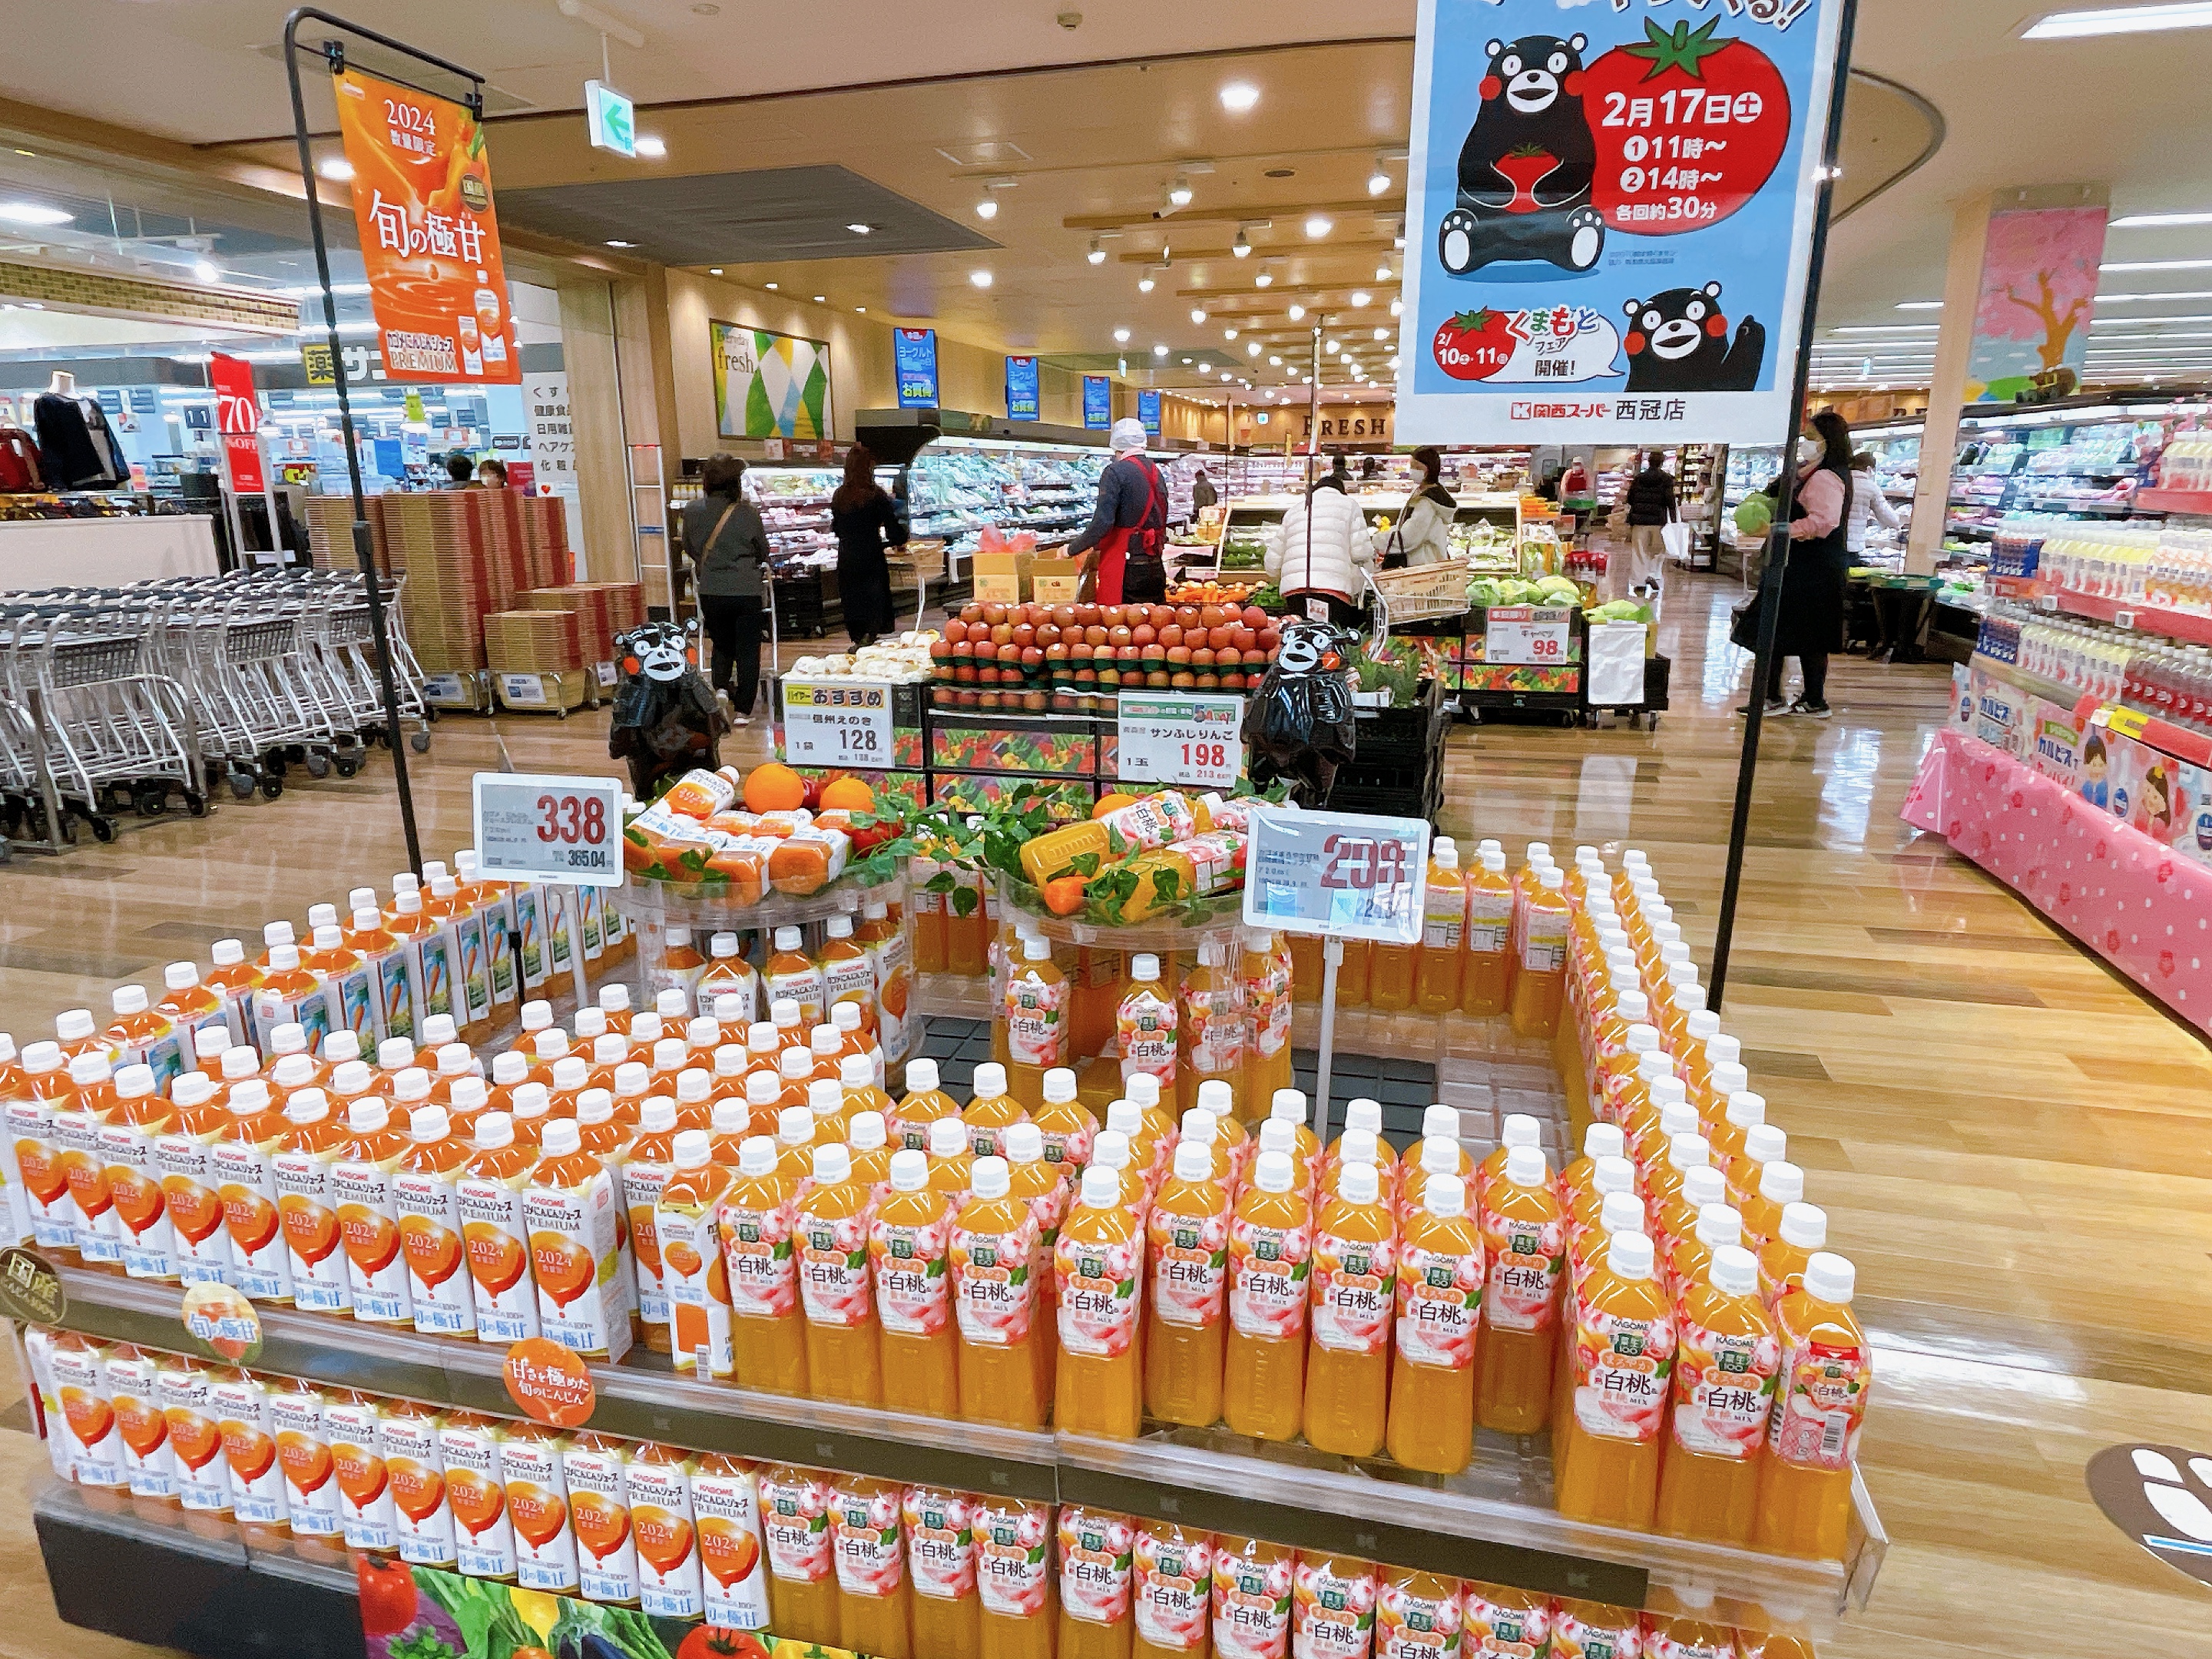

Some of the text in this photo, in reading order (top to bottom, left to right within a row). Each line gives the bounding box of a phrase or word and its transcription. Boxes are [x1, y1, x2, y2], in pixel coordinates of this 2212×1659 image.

[384, 99, 435, 136] 2024
[1615, 195, 1718, 222] 各回約30分
[368, 188, 486, 265] 旬の極甘
[1508, 306, 1598, 343] くまもと
[1535, 337, 1568, 353] フェア
[390, 351, 459, 372] PREMIUM
[717, 346, 754, 374] fresh
[218, 394, 257, 434] 70
[534, 405, 571, 417] 健康食
[1533, 402, 1611, 419] 関西スーパー
[1615, 399, 1686, 422] 西冠店
[537, 423, 573, 435] 日用雑
[1303, 415, 1386, 435] FRESH
[541, 459, 577, 472] 化粧
[1532, 640, 1558, 656] 98
[814, 688, 882, 707] おすすめ
[813, 714, 873, 727] 信州えのき
[839, 728, 877, 751] 128
[1150, 727, 1234, 741] サンふじりんご
[1181, 743, 1225, 767] 198
[536, 794, 607, 845] 338
[1018, 1018, 1044, 1035] 白桃
[1137, 1042, 1167, 1057] 白桃
[226, 1201, 257, 1219] 2024
[286, 1211, 319, 1229] 2024
[345, 1221, 378, 1239] 2024
[1508, 1221, 1542, 1232] KAGOME
[406, 1232, 441, 1251] 2024
[469, 1240, 505, 1258] 2024
[537, 1249, 572, 1267] 2024
[738, 1255, 774, 1276] 白桃
[811, 1263, 848, 1285] 白桃
[889, 1271, 926, 1294] 白桃
[1169, 1261, 1209, 1284] 白桃
[1503, 1267, 1545, 1290] 白桃
[971, 1280, 1011, 1303] 白桃
[1249, 1273, 1290, 1297] 白桃
[1075, 1290, 1114, 1315] 白桃
[1337, 1287, 1377, 1311] 白桃
[1419, 1301, 1462, 1326] 白桃
[190, 1313, 256, 1340] 旬の極甘
[1611, 1319, 1650, 1331] KAGOME
[1715, 1335, 1755, 1348] KAGOME
[1604, 1354, 1651, 1372] まろやか
[1604, 1369, 1651, 1396] 白桃
[1708, 1371, 1757, 1389] まろやか
[518, 1379, 584, 1406] 旬のにんじん
[1708, 1386, 1757, 1412] 白桃
[393, 1473, 424, 1489] 2024
[452, 1484, 484, 1501] 2024
[512, 1496, 546, 1515] 2024
[577, 1507, 611, 1525] 2024
[638, 1522, 674, 1539] 2024
[776, 1526, 810, 1546] 白桃
[704, 1533, 739, 1551] 2024
[846, 1539, 881, 1560] 白桃
[922, 1540, 957, 1561] 白桃
[991, 1557, 1028, 1579] 白桃
[1076, 1562, 1113, 1585] 白桃
[1154, 1587, 1192, 1611] 白桃
[1233, 1606, 1273, 1630] 白桃
[1314, 1621, 1354, 1645] 白桃
